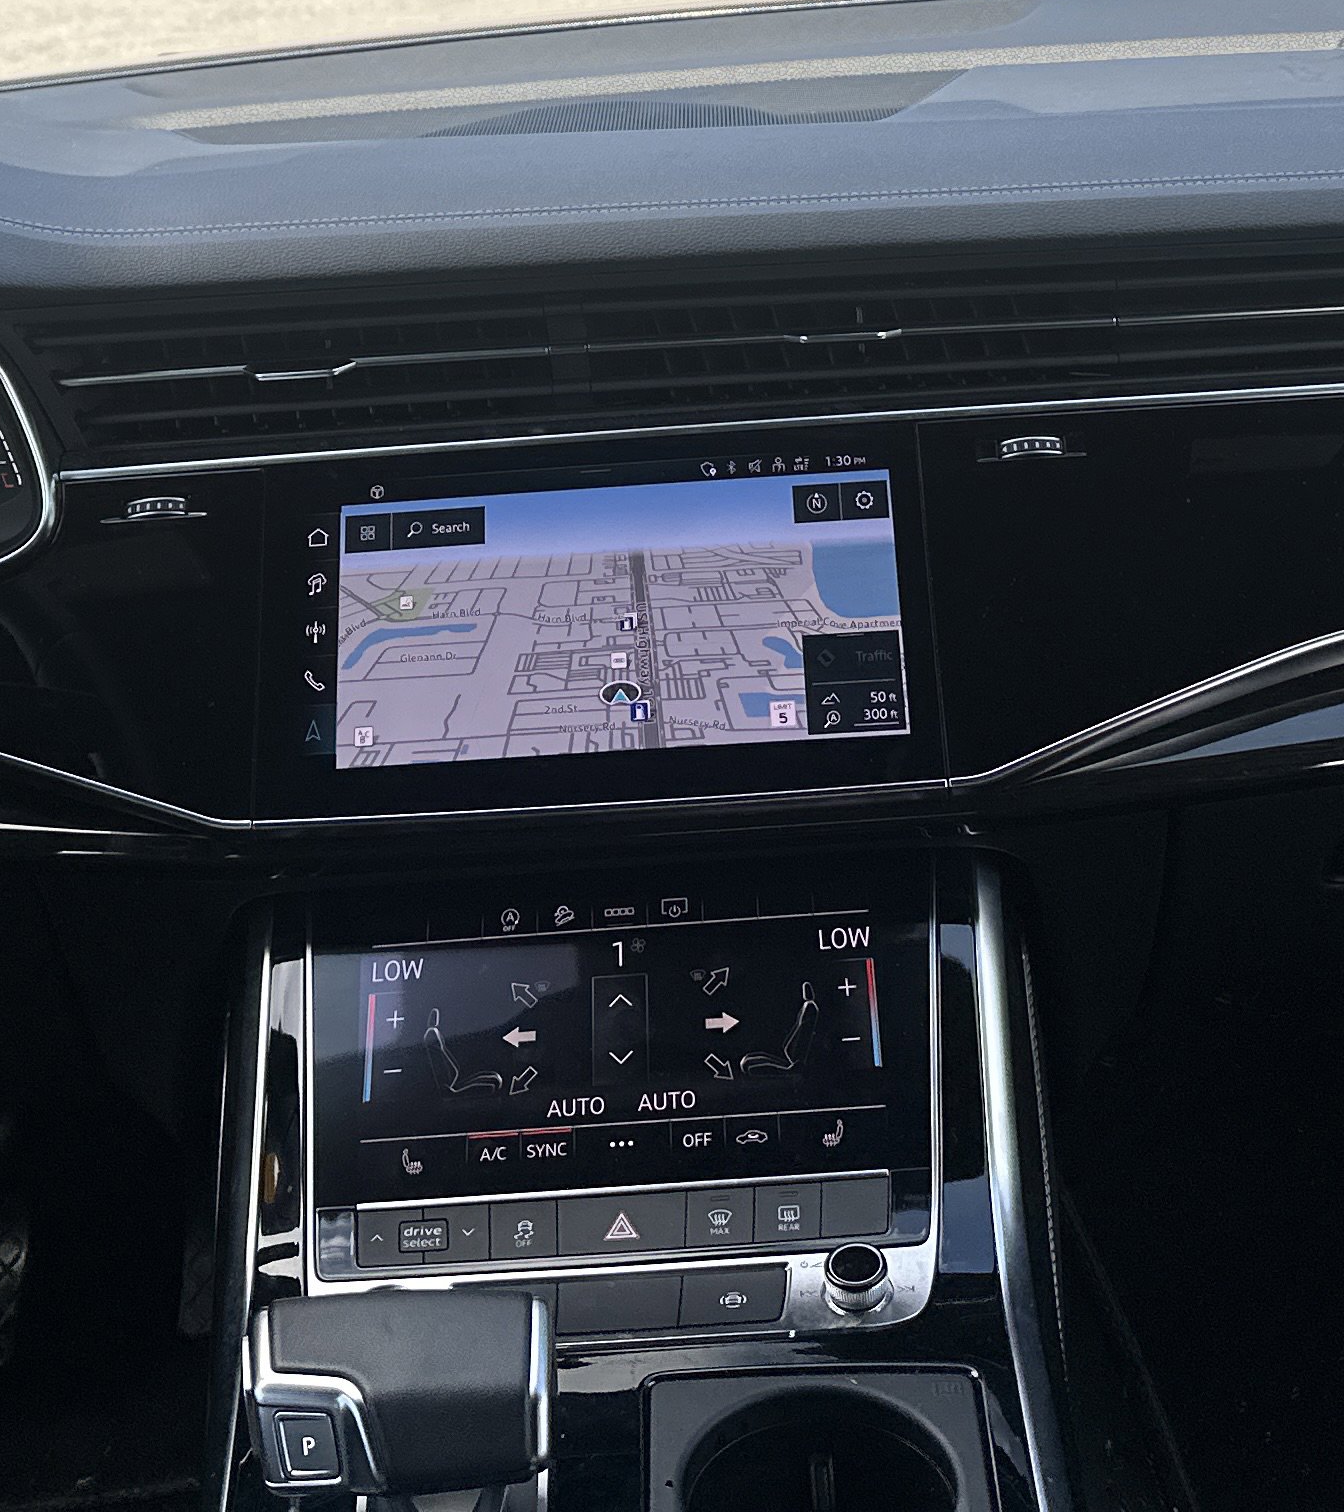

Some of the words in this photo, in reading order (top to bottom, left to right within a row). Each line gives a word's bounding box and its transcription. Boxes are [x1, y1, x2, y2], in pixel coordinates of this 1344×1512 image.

[825, 455, 851, 467] 1:30
[854, 457, 867, 465] PM
[431, 521, 470, 535] Search
[458, 608, 481, 618] Blvd
[565, 613, 588, 622] Blvd
[345, 618, 366, 635] Blvd
[777, 618, 820, 629] Imperial
[635, 626, 653, 685] Highway
[856, 649, 893, 662] Traffic
[870, 691, 887, 703] 50
[889, 692, 898, 703] ft
[544, 705, 563, 714] 2nd
[567, 705, 578, 714] St
[864, 708, 888, 720] 300
[890, 709, 899, 719] ft
[669, 716, 709, 731] Nursery
[713, 721, 727, 731] Rd
[779, 712, 788, 724] 5
[559, 724, 598, 734] Nursery
[603, 723, 616, 732] Rd
[503, 924, 516, 932] OFF
[819, 926, 870, 950] LOW
[612, 941, 623, 967] 1
[372, 958, 424, 983] LOW
[547, 1096, 605, 1118] AUTO
[638, 1090, 696, 1112] AUTO
[683, 1132, 712, 1148] OFF
[479, 1147, 507, 1162] A/C
[526, 1142, 567, 1158] SYNC
[403, 1226, 443, 1237] drive
[709, 1227, 730, 1235] MAX
[778, 1223, 800, 1231] REAR
[402, 1238, 441, 1248] select
[515, 1240, 532, 1248] OFF
[302, 1436, 316, 1456] P
